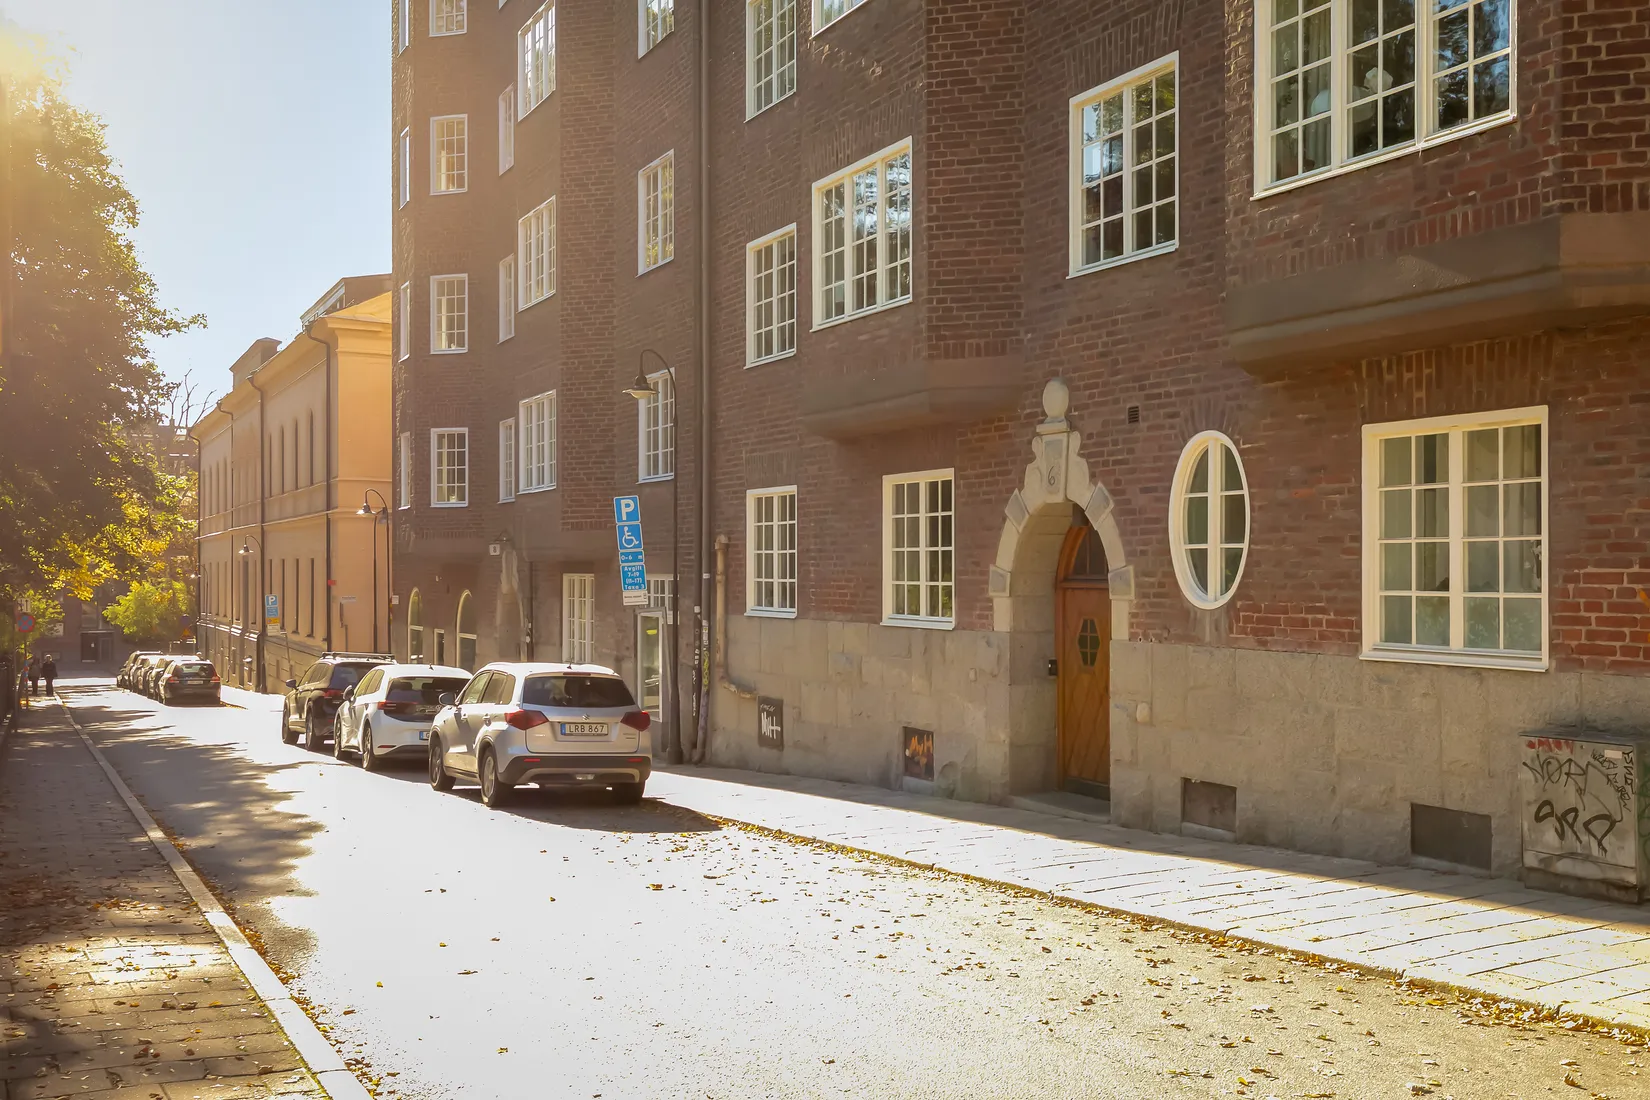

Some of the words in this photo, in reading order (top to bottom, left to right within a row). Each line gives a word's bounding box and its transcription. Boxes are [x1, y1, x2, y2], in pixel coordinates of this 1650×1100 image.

[1047, 465, 1056, 486] 6
[620, 499, 635, 521] P
[268, 595, 276, 605] P
[568, 725, 585, 733] LRB
[588, 725, 605, 733] 867
